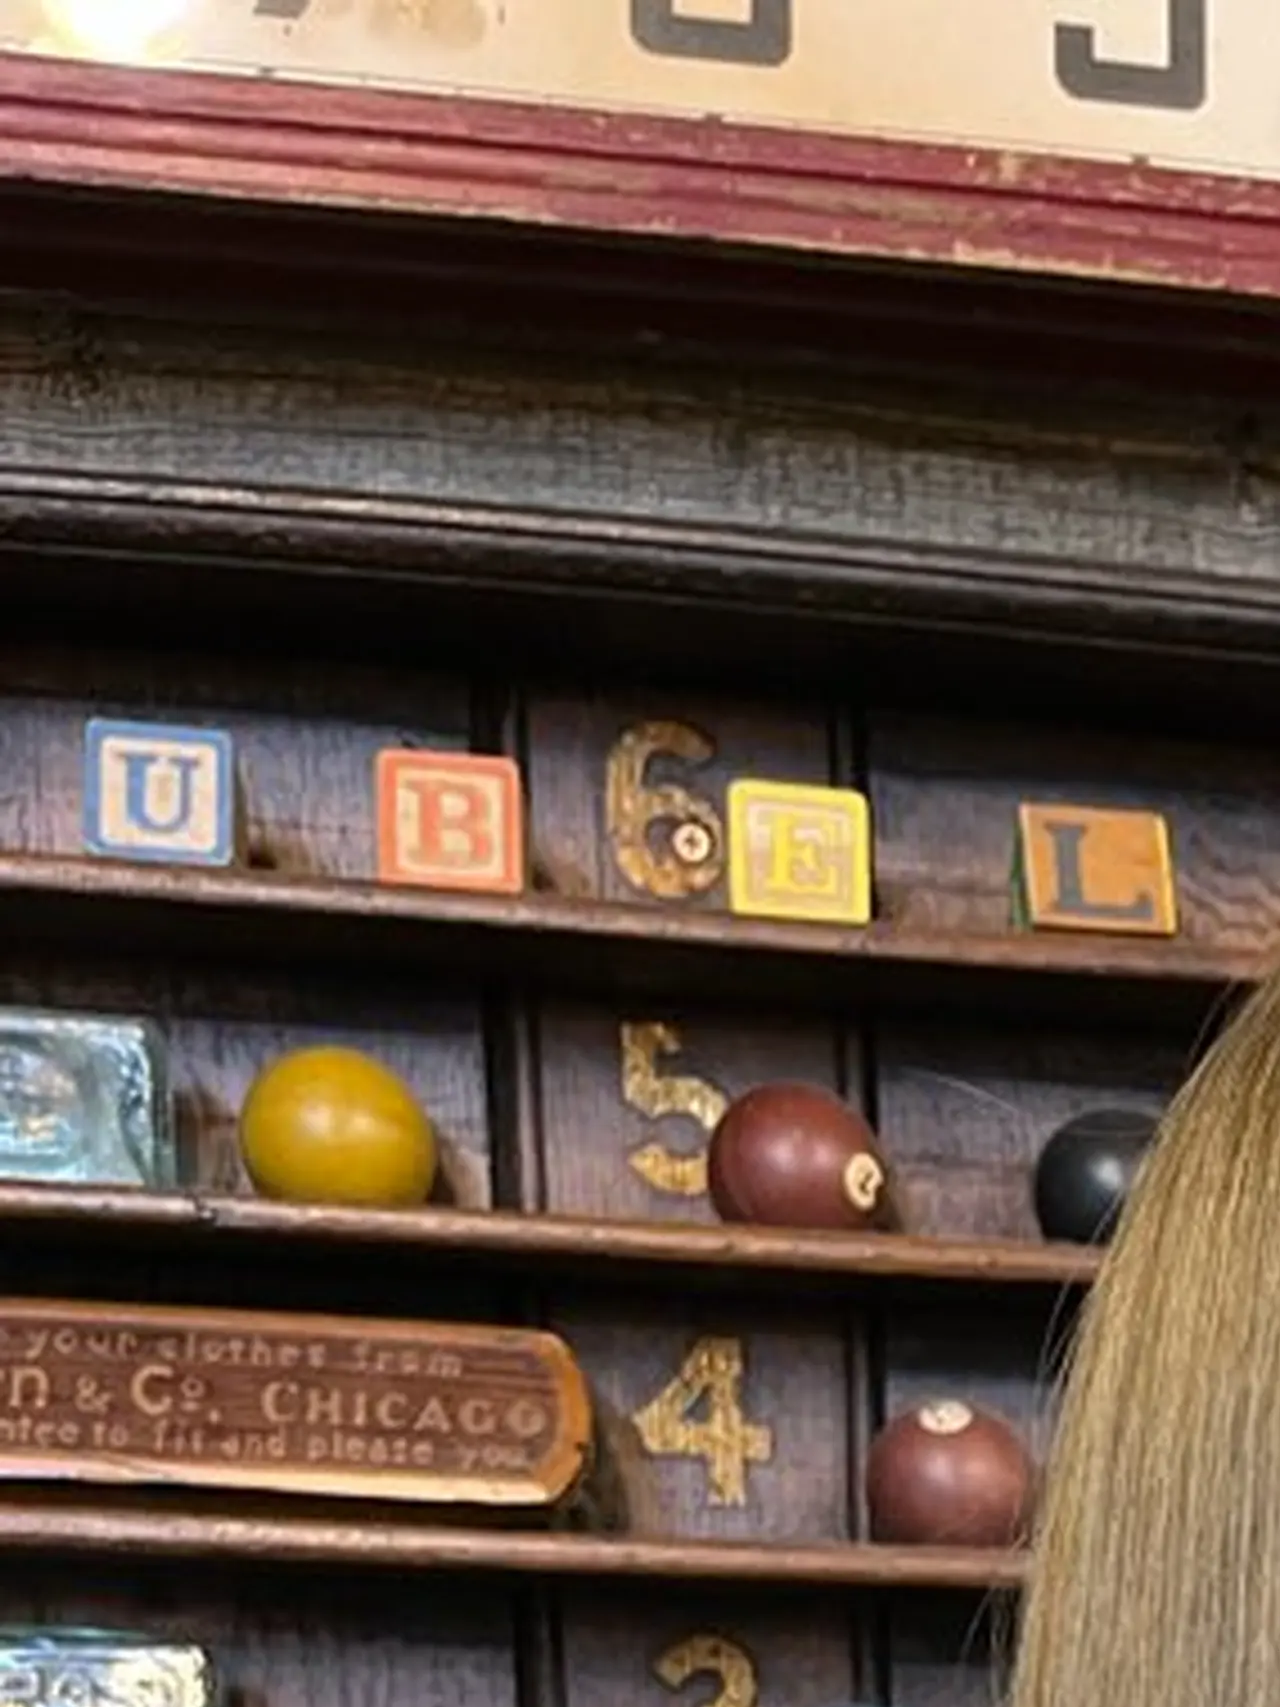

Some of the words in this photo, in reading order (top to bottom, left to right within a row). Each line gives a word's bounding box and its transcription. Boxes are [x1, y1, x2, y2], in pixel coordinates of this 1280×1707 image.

[114, 749, 203, 833] U
[401, 780, 495, 866] B
[764, 811, 838, 895] E
[1042, 822, 1155, 919] L
[607, 720, 724, 897] 6
[620, 1020, 728, 1196] 5
[24, 1328, 137, 1360] your
[156, 1331, 328, 1369] clothes
[74, 1375, 114, 1414] &
[261, 1381, 547, 1438] CHICAGO
[632, 1337, 772, 1507] 4
[220, 1425, 286, 1458] and
[306, 1430, 434, 1467] please
